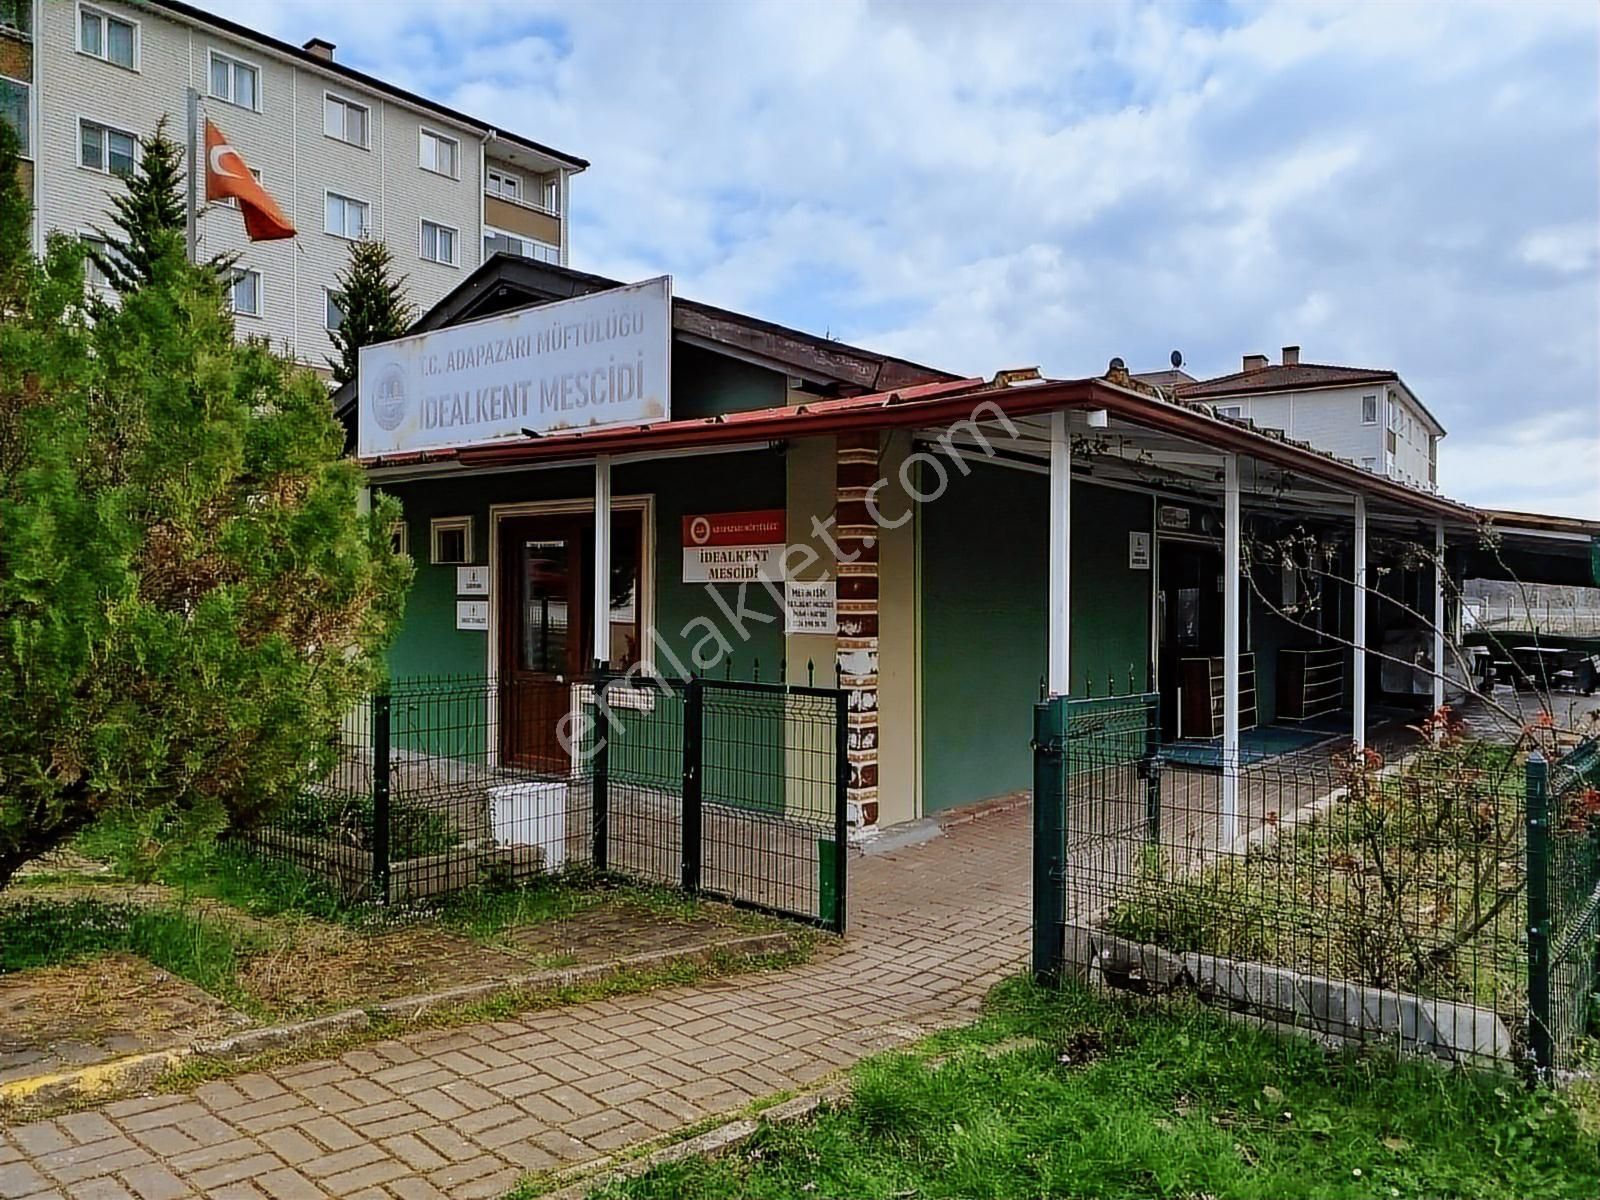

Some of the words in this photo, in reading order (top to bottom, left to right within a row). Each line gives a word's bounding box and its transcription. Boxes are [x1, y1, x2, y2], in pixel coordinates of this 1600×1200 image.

[446, 334, 531, 373] ADAPAZARI
[539, 350, 644, 414] MESCİDİ
[699, 548, 769, 563] İDEALKENT
[708, 564, 759, 580] MESCİDİ
